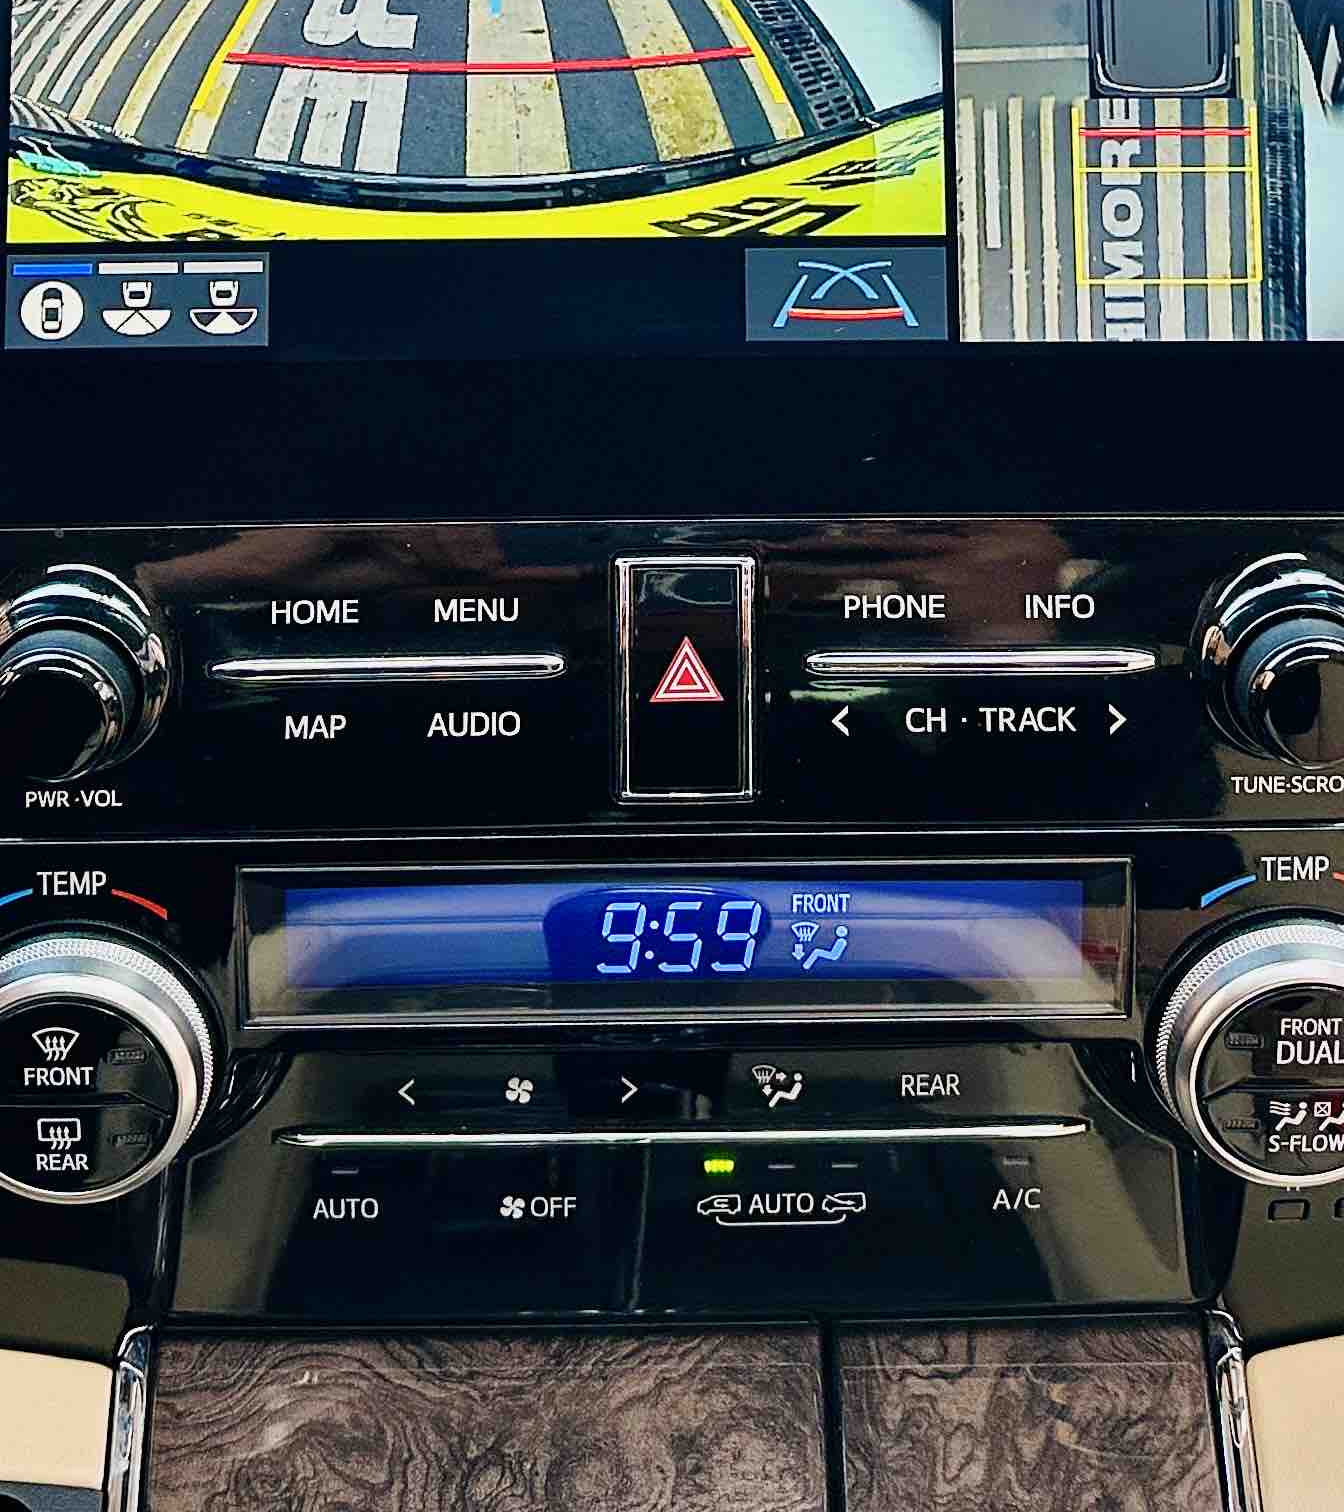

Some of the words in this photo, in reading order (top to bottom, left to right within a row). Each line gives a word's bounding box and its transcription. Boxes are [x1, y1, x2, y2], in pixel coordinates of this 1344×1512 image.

[272, 600, 359, 624] HOME
[435, 598, 518, 623] MENU
[844, 594, 946, 619] PHONE
[1025, 594, 1095, 619] INFO
[284, 715, 347, 739] MAP
[427, 711, 520, 737] AUDIO
[906, 708, 946, 732] CH
[979, 707, 1076, 732] TRACK
[1261, 856, 1329, 881] TEMP
[37, 871, 106, 896] TEMP
[792, 894, 850, 912] FRONT
[597, 900, 762, 973] 9:59
[1281, 1018, 1342, 1035] FRONT
[24, 1067, 93, 1086] FRONT
[901, 1074, 960, 1097] REAR
[36, 1154, 89, 1171] REAR
[313, 1198, 378, 1219] AUTO
[530, 1197, 577, 1218] OFF
[749, 1192, 814, 1214] AUTO
[992, 1187, 1041, 1210] A/C
